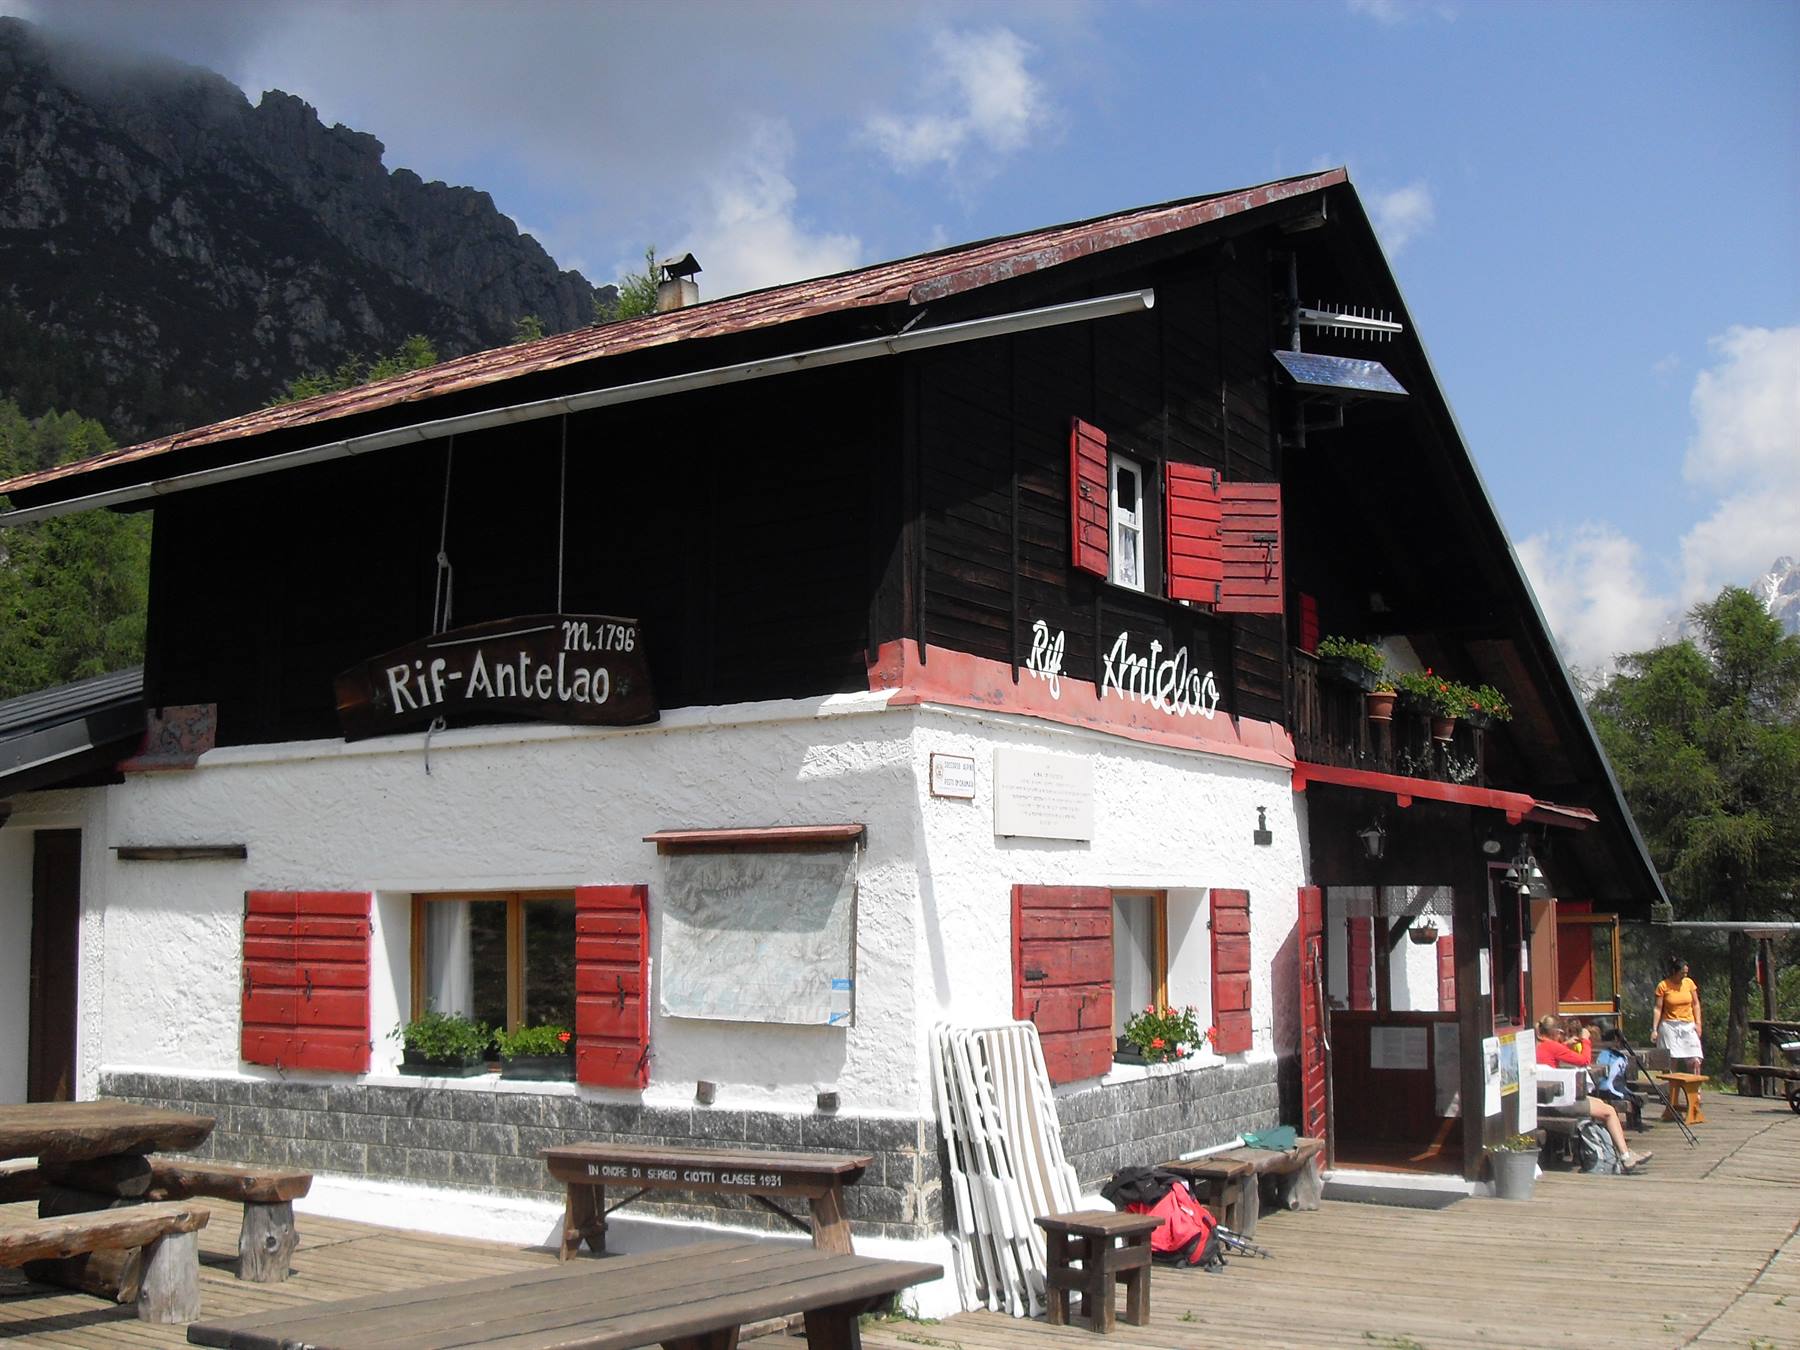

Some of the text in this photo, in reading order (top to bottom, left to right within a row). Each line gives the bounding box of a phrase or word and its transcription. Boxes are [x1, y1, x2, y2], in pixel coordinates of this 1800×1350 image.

[588, 1164, 782, 1187] IN ONORE DI SERGIO CIOTTI CLASSE 1931
